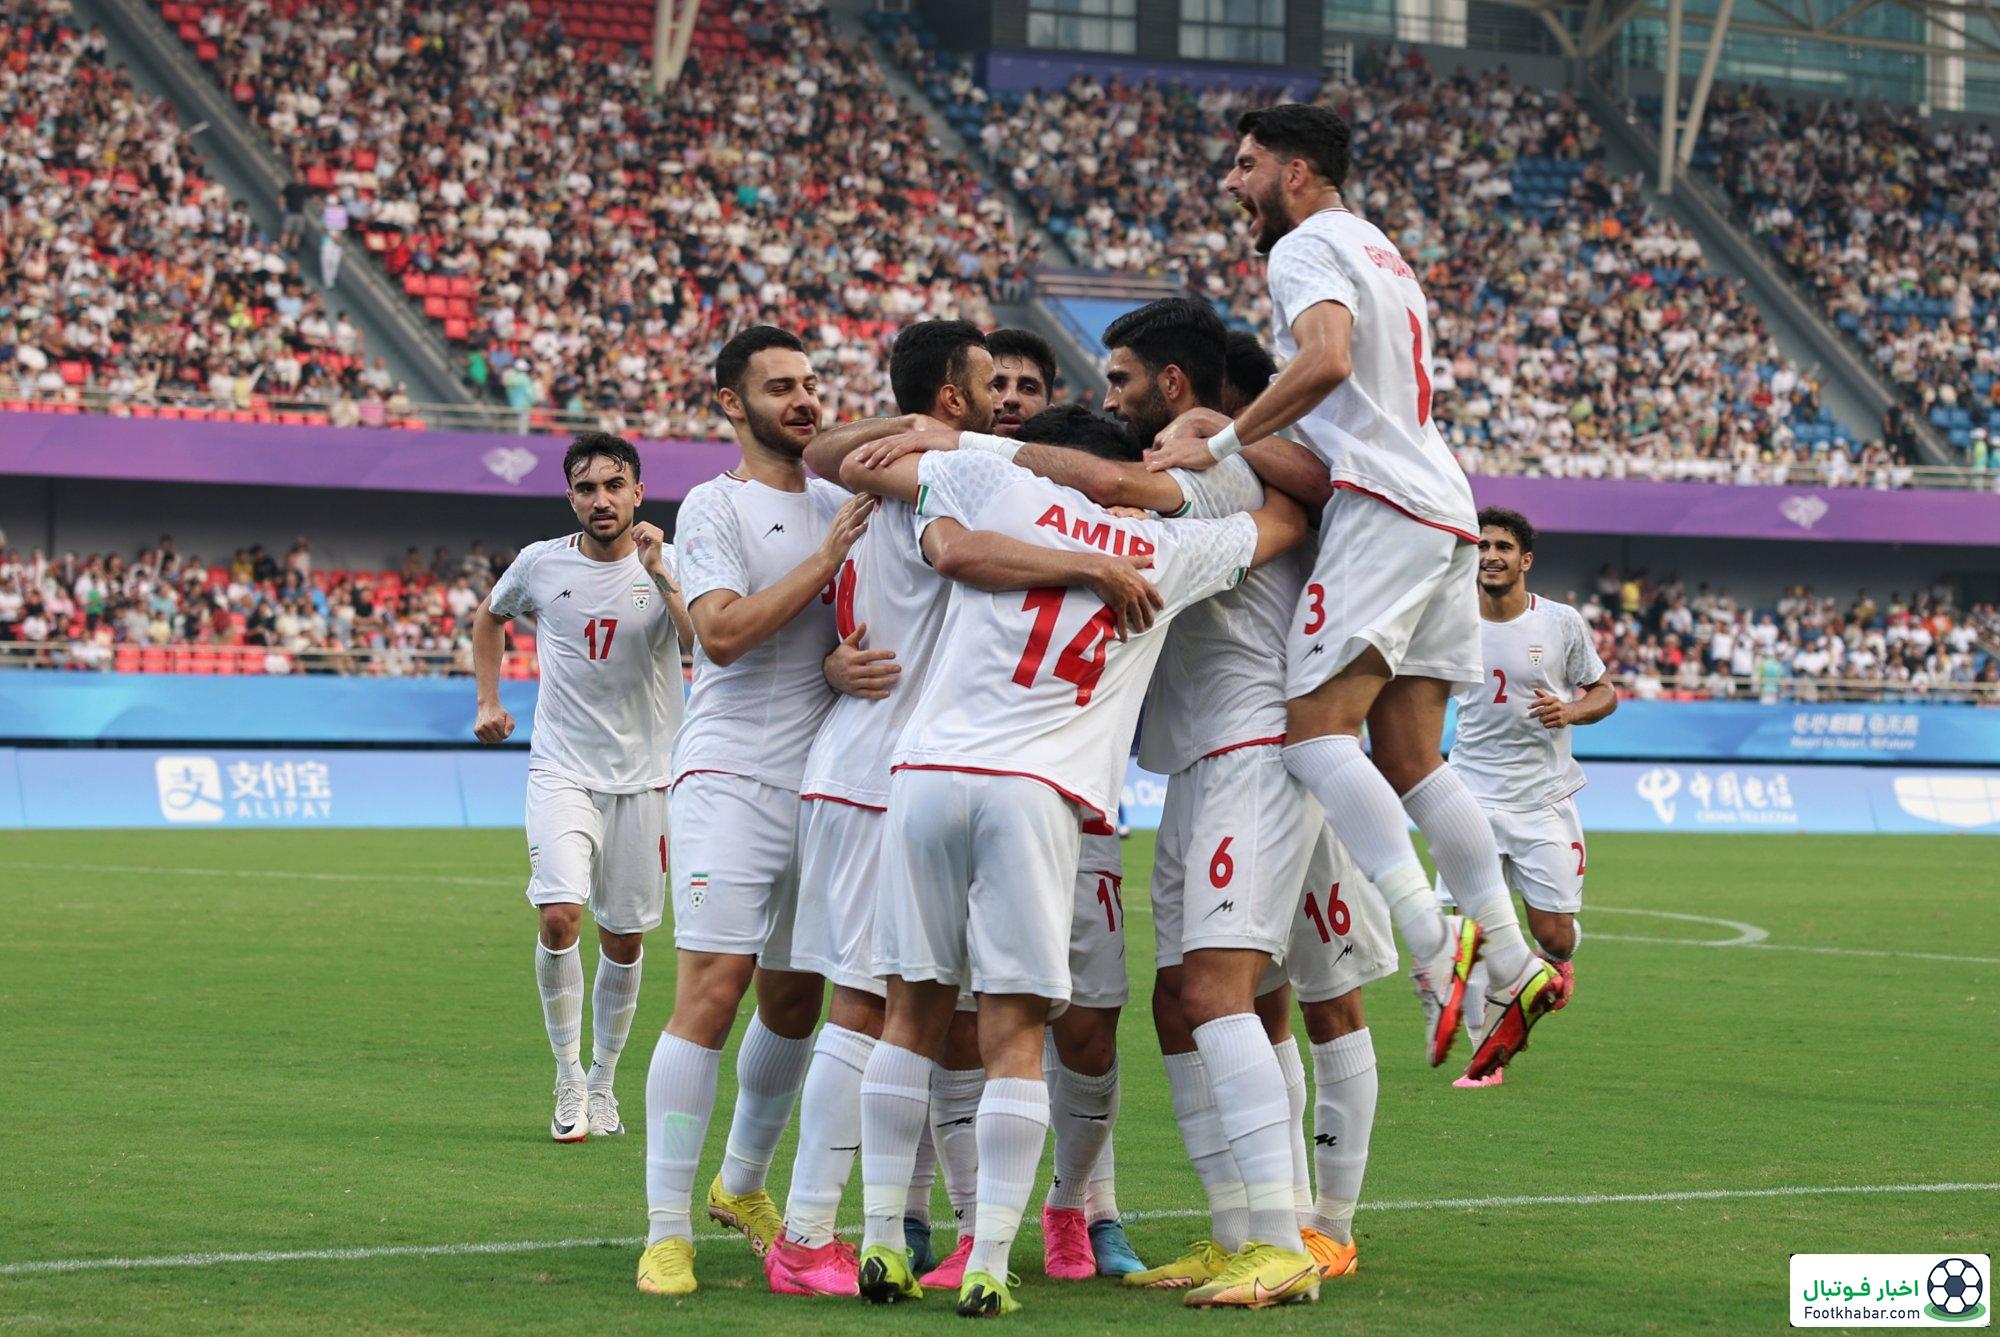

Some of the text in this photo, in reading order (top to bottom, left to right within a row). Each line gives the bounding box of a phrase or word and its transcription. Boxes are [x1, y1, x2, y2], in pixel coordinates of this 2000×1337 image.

[1035, 504, 1156, 570] AMIR
[1303, 583, 1326, 636] 3
[584, 618, 619, 661] 17
[1011, 586, 1117, 707] 14
[1493, 668, 1508, 704] 2
[227, 760, 333, 799] 支付宝
[237, 800, 332, 819] ALIPAY
[1209, 836, 1234, 889] 6
[1304, 882, 1351, 944] 16
